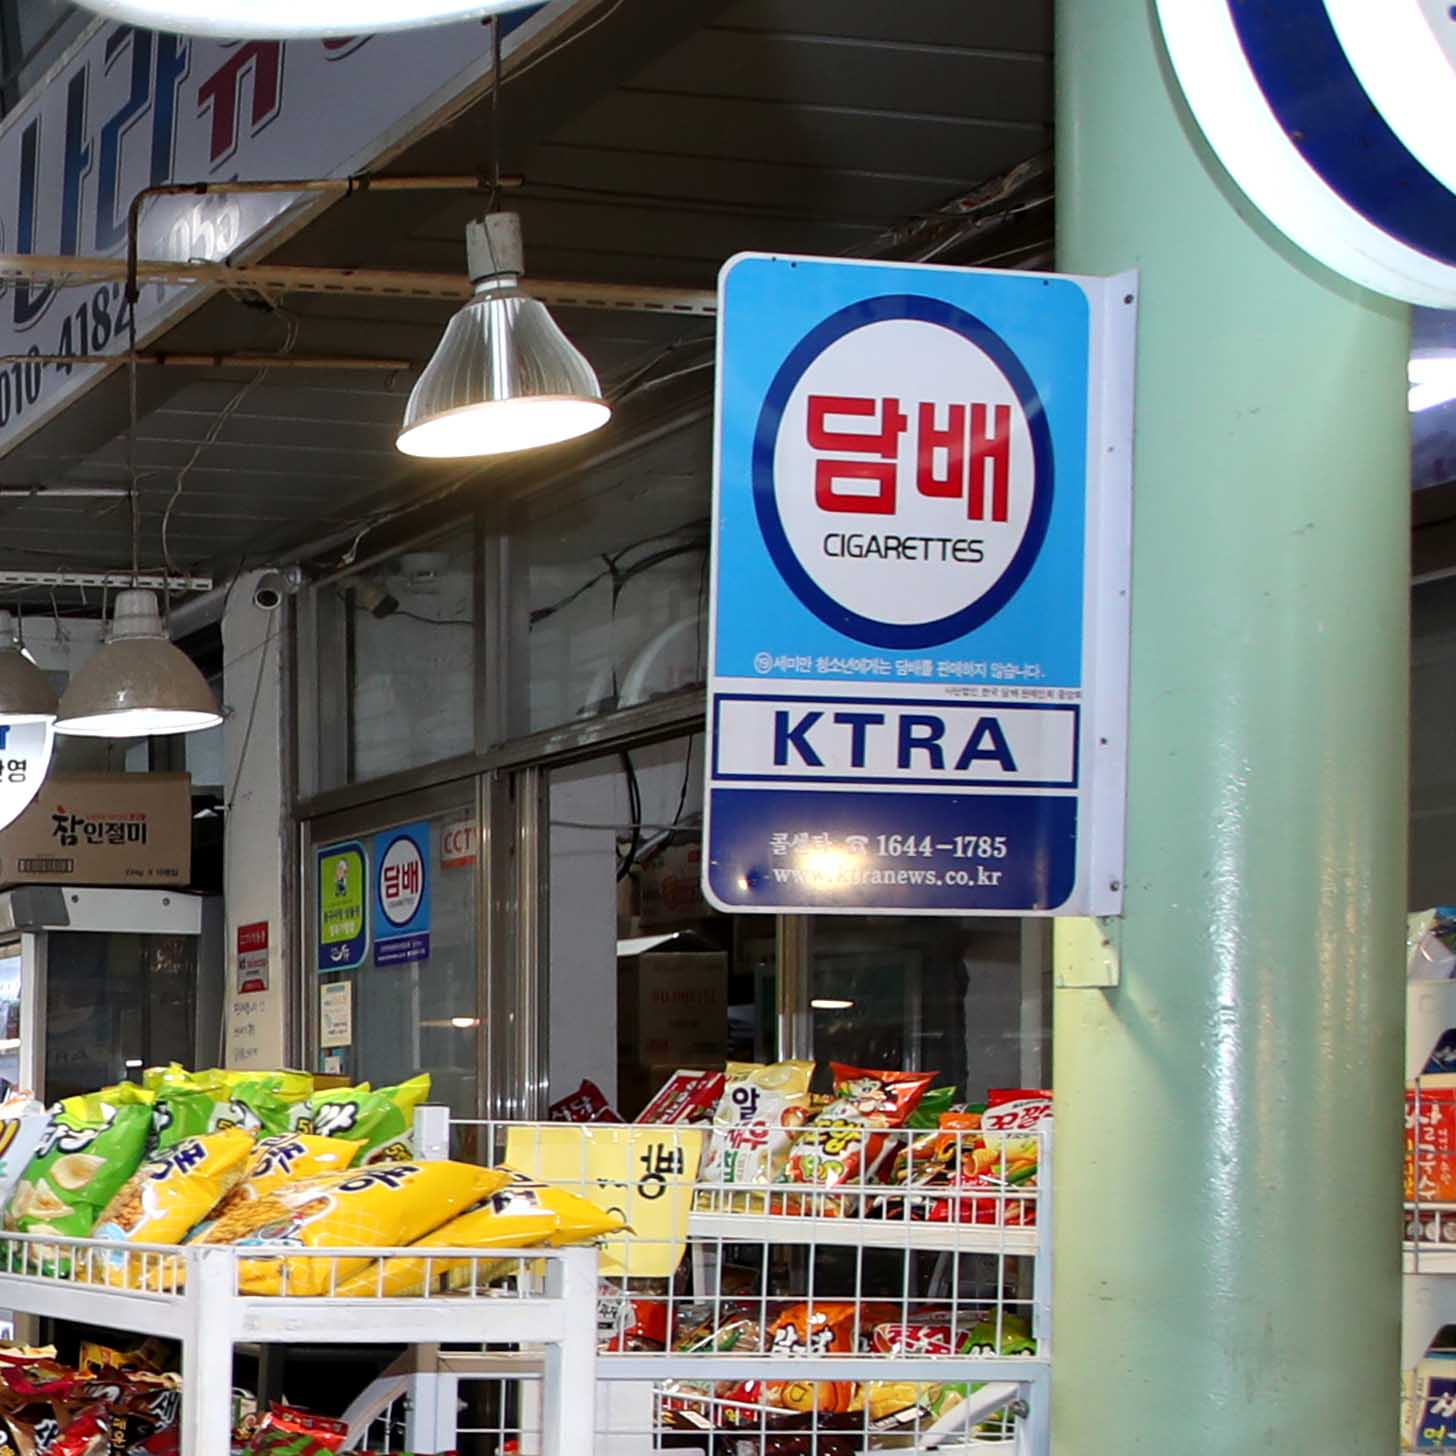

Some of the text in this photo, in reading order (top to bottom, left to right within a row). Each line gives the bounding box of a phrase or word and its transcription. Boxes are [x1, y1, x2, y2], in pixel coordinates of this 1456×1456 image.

[806, 394, 1012, 524] 담배
[823, 533, 985, 564] CIGARETTES
[772, 710, 1020, 774] KTRA
[443, 826, 478, 854] CCT
[876, 835, 1007, 858] 1644-1785
[383, 861, 420, 900] 담배
